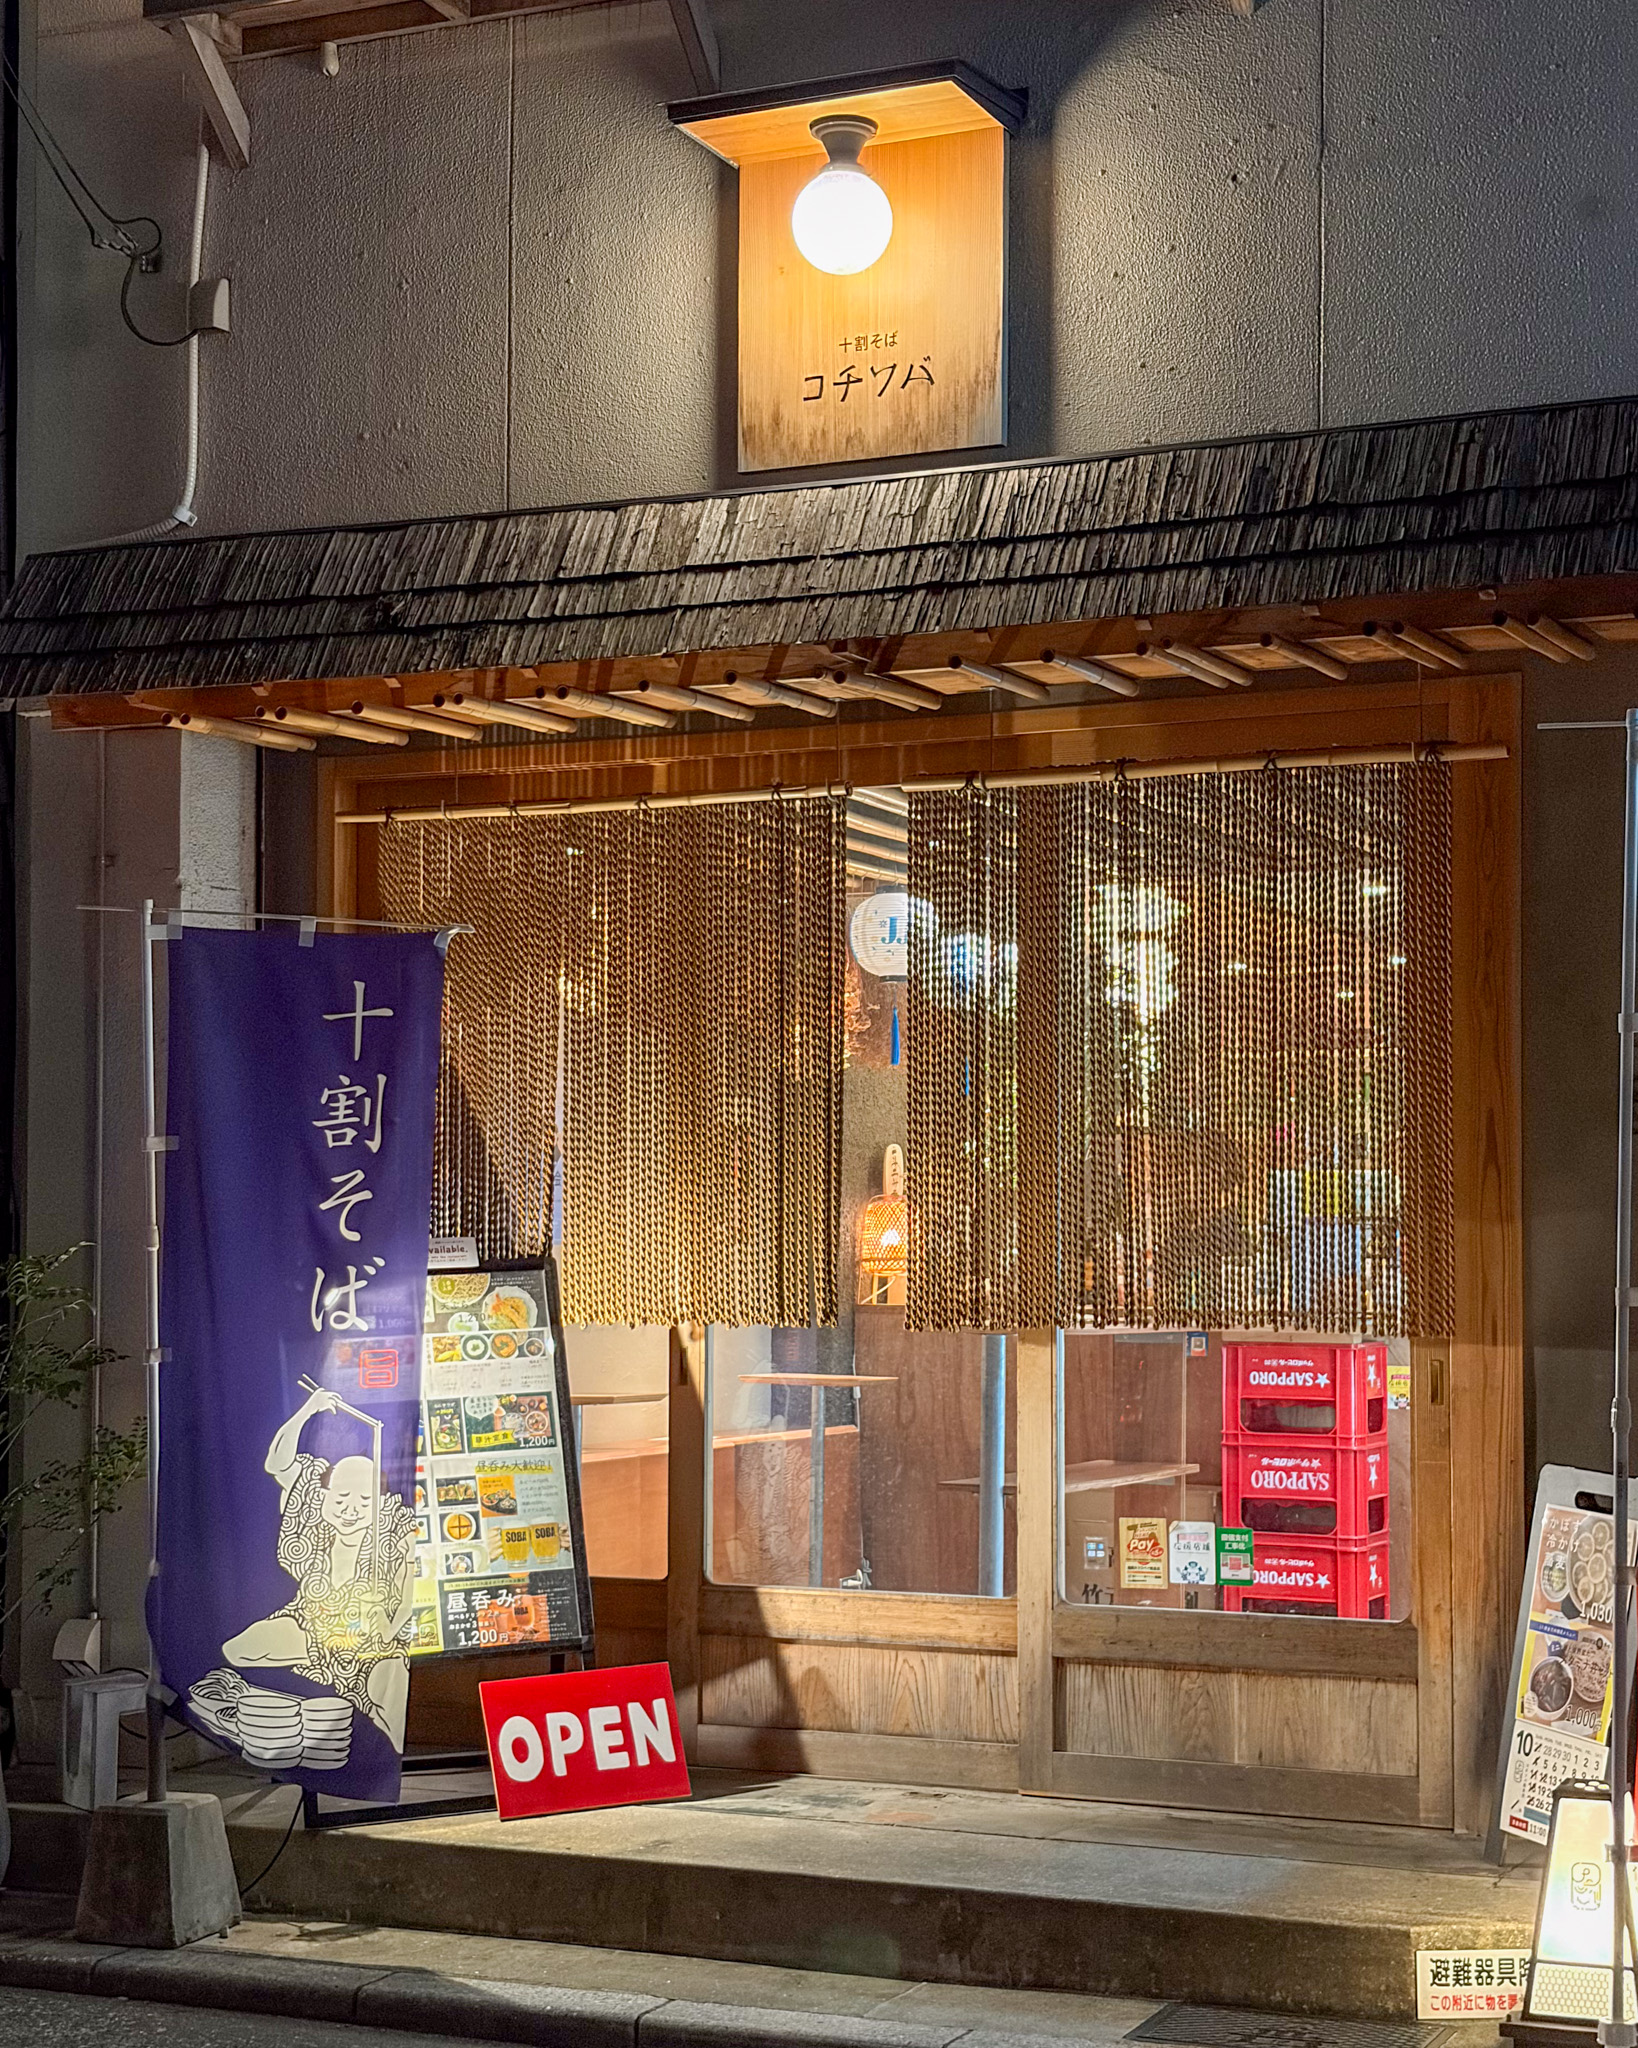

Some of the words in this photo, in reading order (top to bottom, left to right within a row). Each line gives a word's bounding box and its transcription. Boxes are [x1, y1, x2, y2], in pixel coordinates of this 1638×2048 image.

[838, 330, 898, 353] 十割そば
[803, 355, 935, 402] コチソバ
[312, 980, 394, 1333] 十割そば
[429, 1244, 468, 1254] vailable.
[1250, 1371, 1314, 1386] SAPPORO
[519, 1436, 555, 1448] 1,200円
[1260, 1457, 1311, 1468] サッポロビール
[1251, 1470, 1329, 1491] SAPPORO
[1549, 1516, 1581, 1532] かぼす
[505, 1531, 527, 1543] SOBA
[535, 1526, 555, 1539] SOBA
[1545, 1533, 1579, 1553] 冷かけ
[1129, 1539, 1155, 1552] Pay
[447, 1589, 515, 1613] 昼呑み
[1580, 1601, 1613, 1624] 1,030
[458, 1628, 509, 1647] 1,200円
[1517, 1730, 1533, 1757] 10
[1543, 1760, 1548, 1769] 5
[1552, 1762, 1557, 1772] 6
[1562, 1766, 1567, 1775] 7
[1553, 1748, 1562, 1759] 29
[1562, 1751, 1571, 1762] 30
[1574, 1755, 1579, 1764] 1
[1583, 1758, 1589, 1768] 2
[1594, 1761, 1600, 1771] 3
[1549, 1775, 1557, 1786] 13
[1538, 1785, 1546, 1797] 19
[1547, 1788, 1552, 1798] 2
[1535, 1798, 1544, 1810] 26
